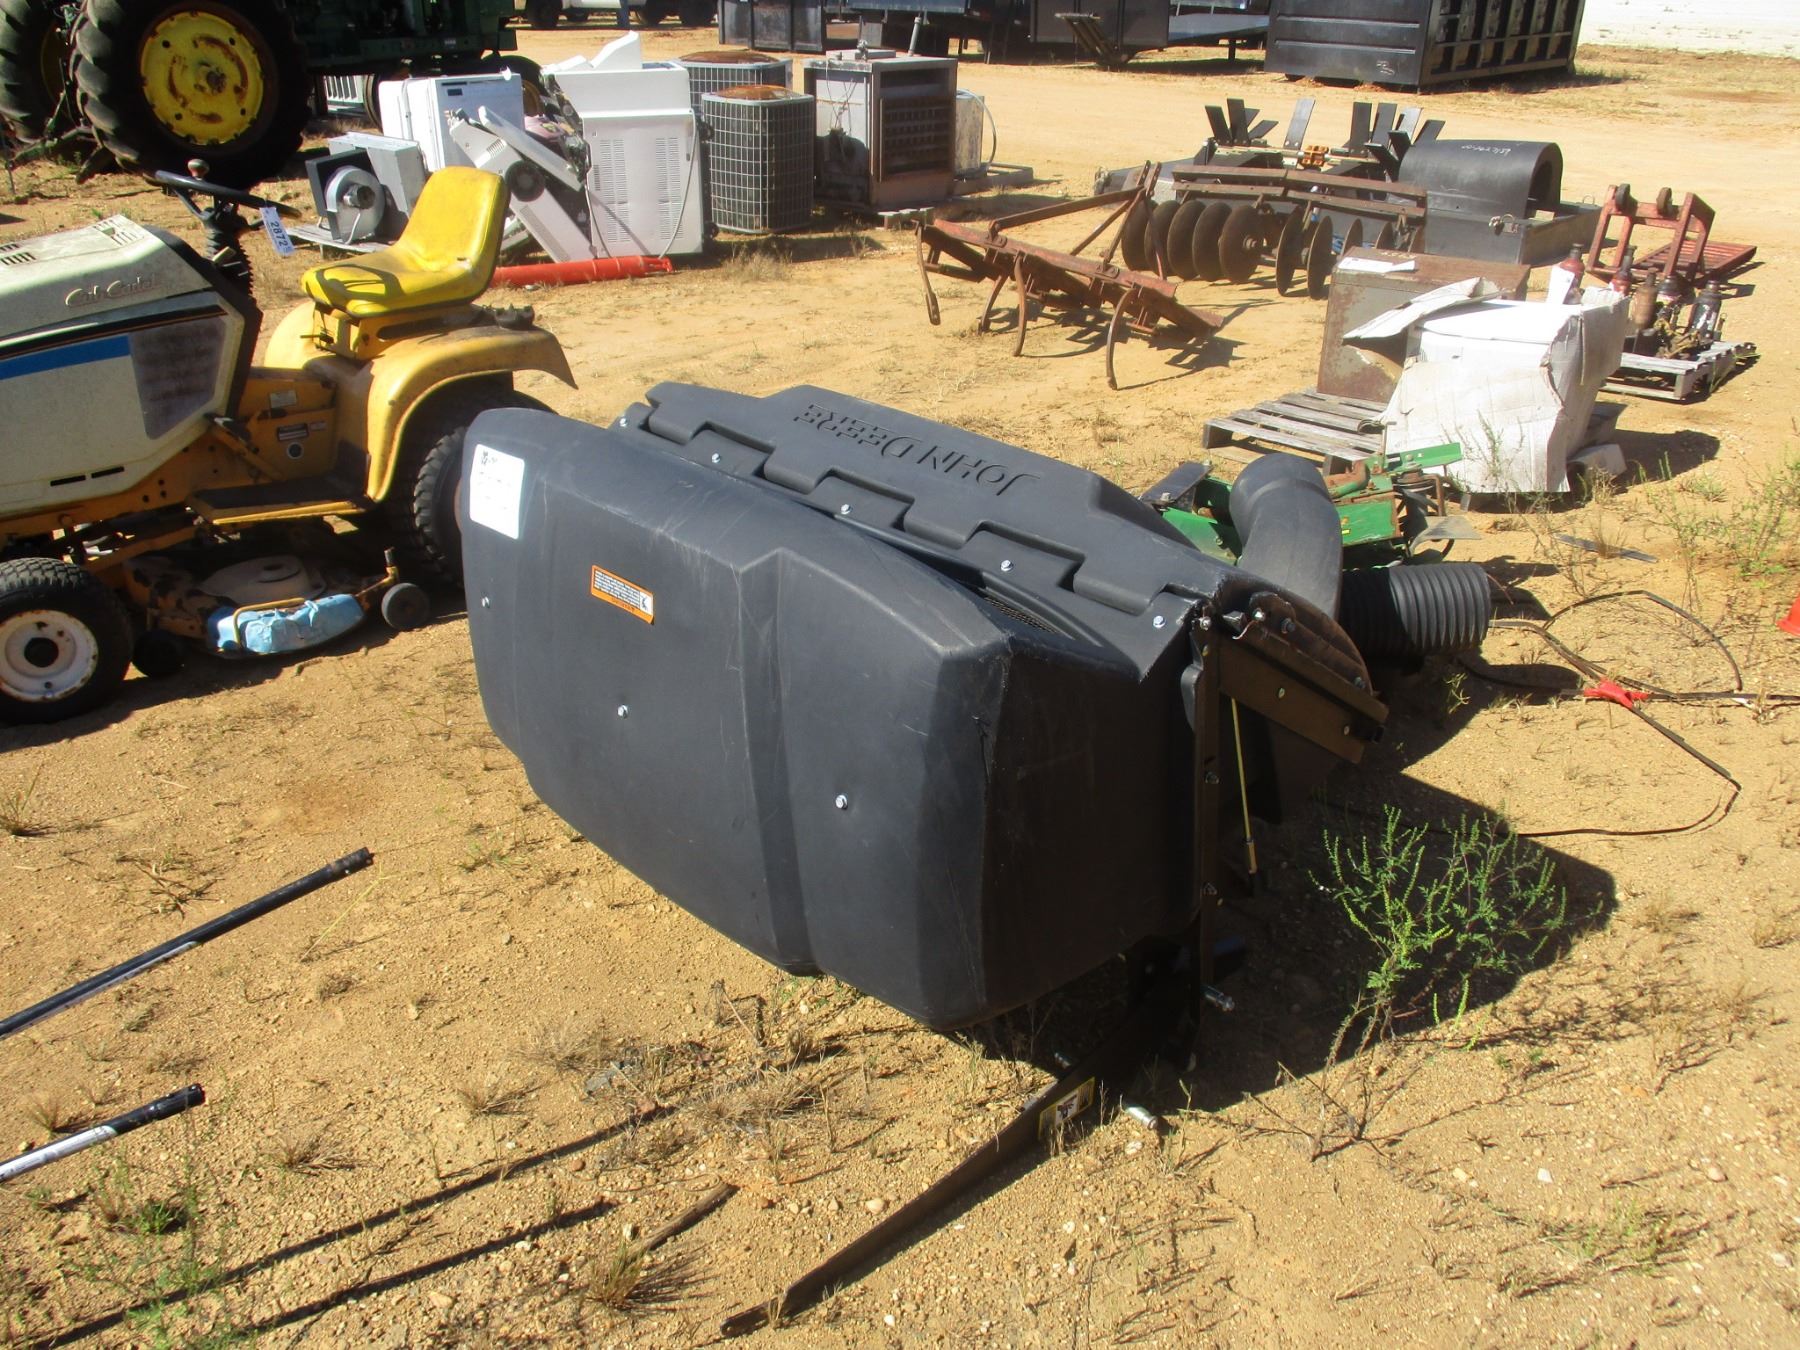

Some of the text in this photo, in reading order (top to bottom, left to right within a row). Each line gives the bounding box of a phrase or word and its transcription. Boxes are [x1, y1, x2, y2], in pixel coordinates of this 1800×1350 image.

[270, 220, 289, 247] 2872
[793, 403, 1041, 497] JOHN DEERE
